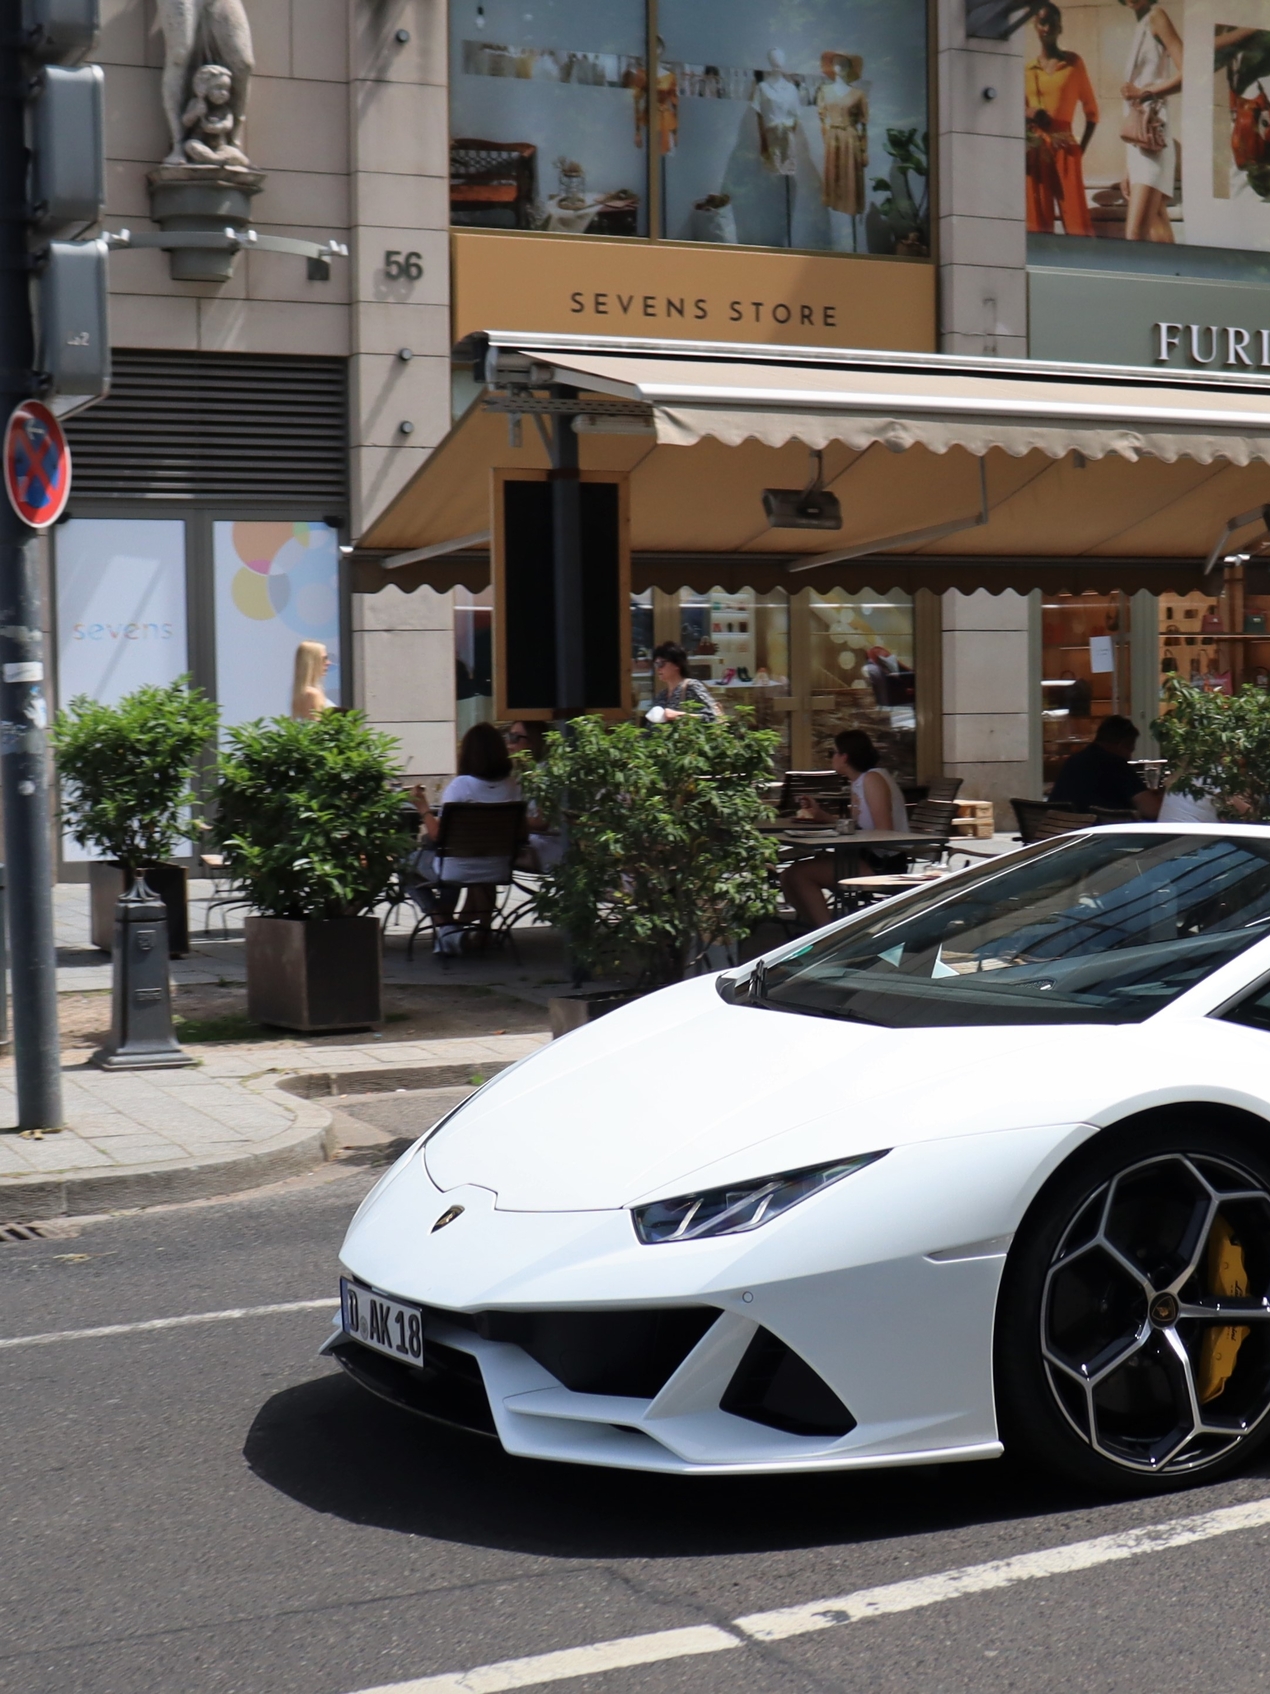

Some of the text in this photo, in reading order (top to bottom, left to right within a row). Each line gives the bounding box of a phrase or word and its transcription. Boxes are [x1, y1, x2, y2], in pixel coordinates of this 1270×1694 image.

[383, 250, 423, 281] 56
[570, 292, 838, 327] SEVENS STORE
[72, 623, 173, 642] sevens
[395, 1309, 422, 1360] 18
